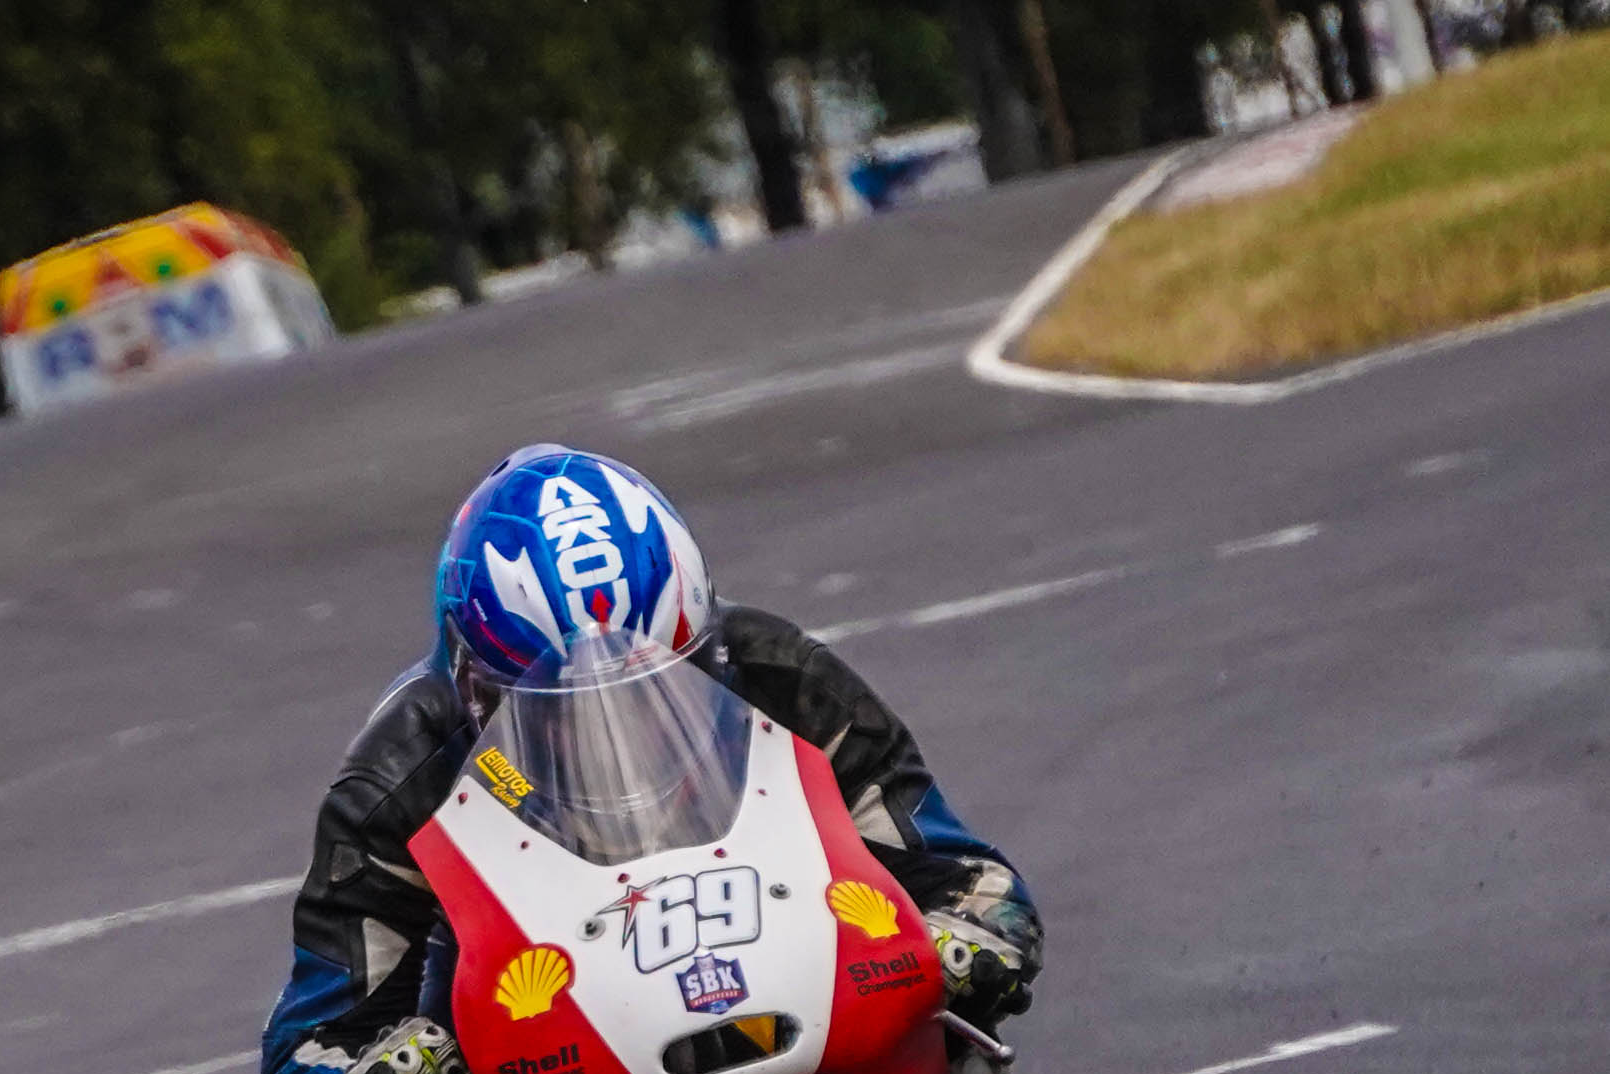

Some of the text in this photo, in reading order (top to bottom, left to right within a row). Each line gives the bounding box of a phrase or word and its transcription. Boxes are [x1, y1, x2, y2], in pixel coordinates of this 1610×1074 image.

[632, 865, 762, 975] 69
[686, 965, 742, 1001] SBK
[847, 951, 921, 983] Shell
